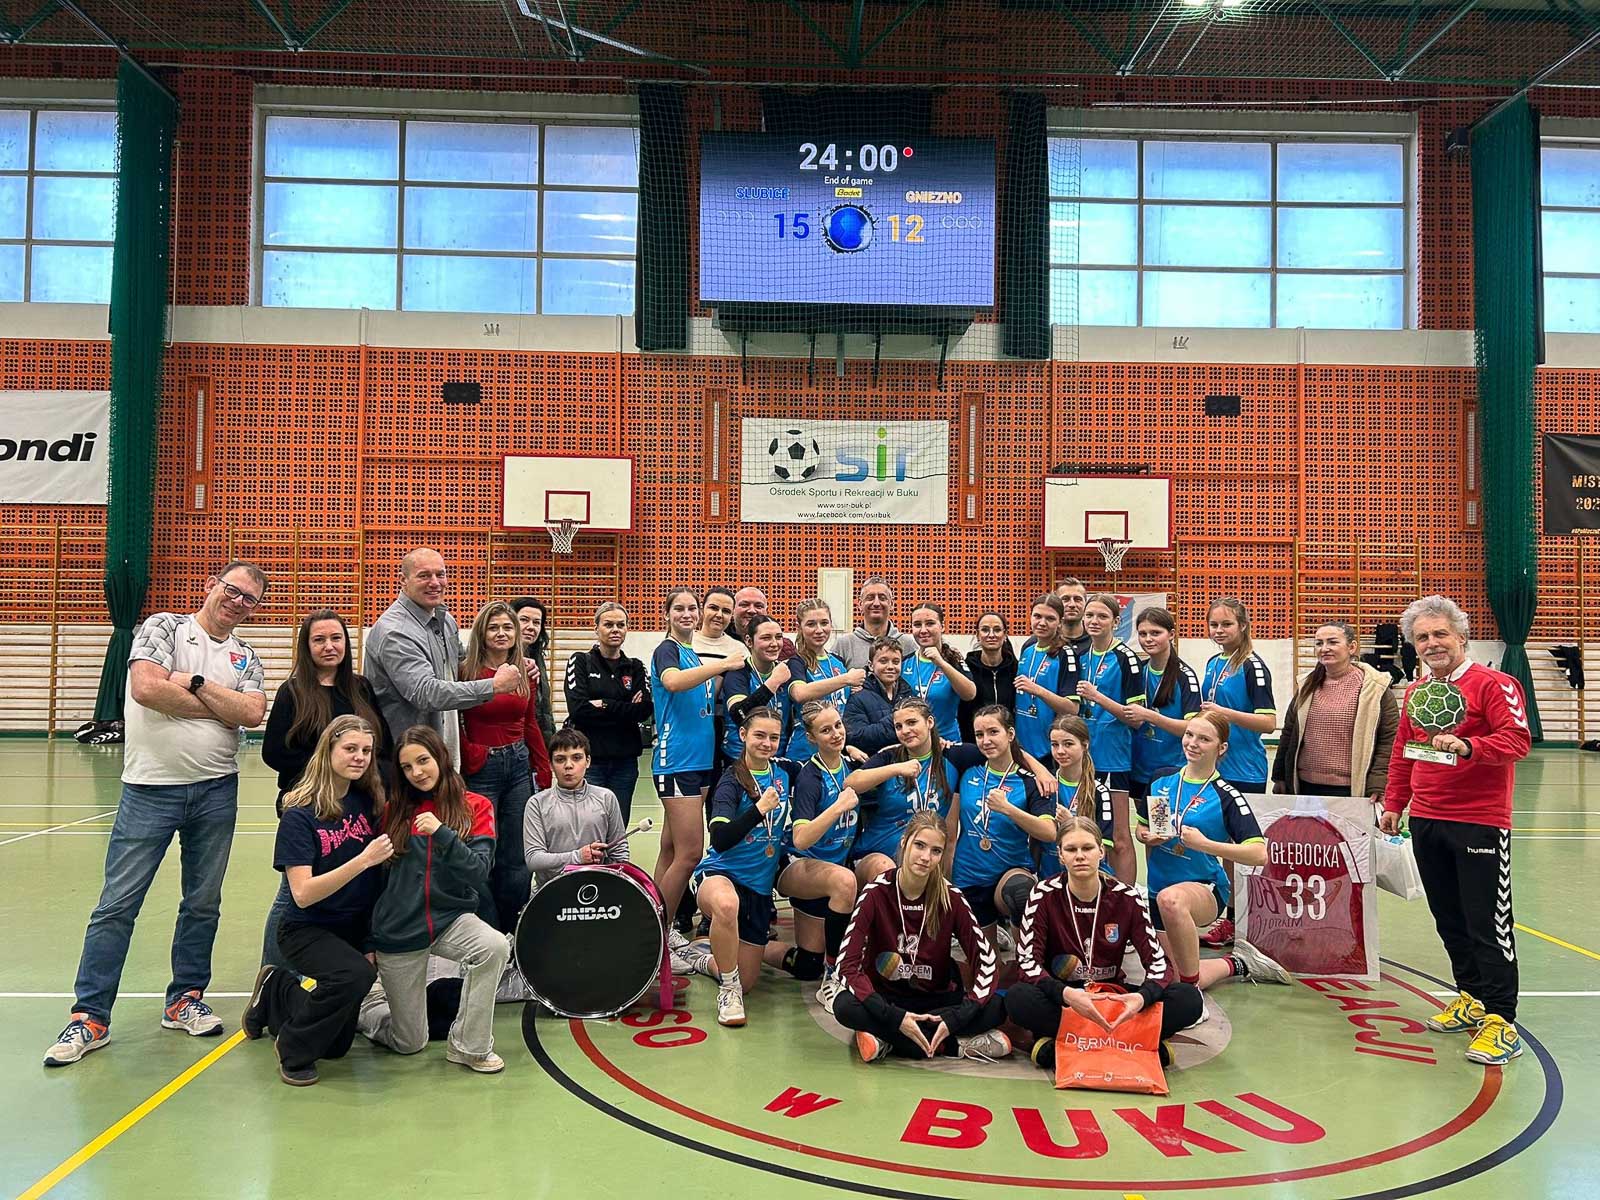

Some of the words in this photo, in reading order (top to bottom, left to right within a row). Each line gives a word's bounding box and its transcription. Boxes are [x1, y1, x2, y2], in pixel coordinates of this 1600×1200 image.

[824, 176, 839, 185] End
[841, 176, 850, 185] of
[851, 177, 873, 187] game
[773, 212, 810, 239] 15
[887, 214, 925, 242] 12
[769, 487, 806, 497] Ośrodek
[808, 488, 837, 499] Sportu
[844, 488, 885, 499] Rekreacji
[896, 488, 919, 498] Buku
[1270, 841, 1340, 870] GŁĘBOCKA
[1466, 846, 1496, 855] hummel
[1285, 873, 1327, 921] 33
[556, 905, 621, 922] JINDAO
[899, 1091, 1327, 1160] BUKU
